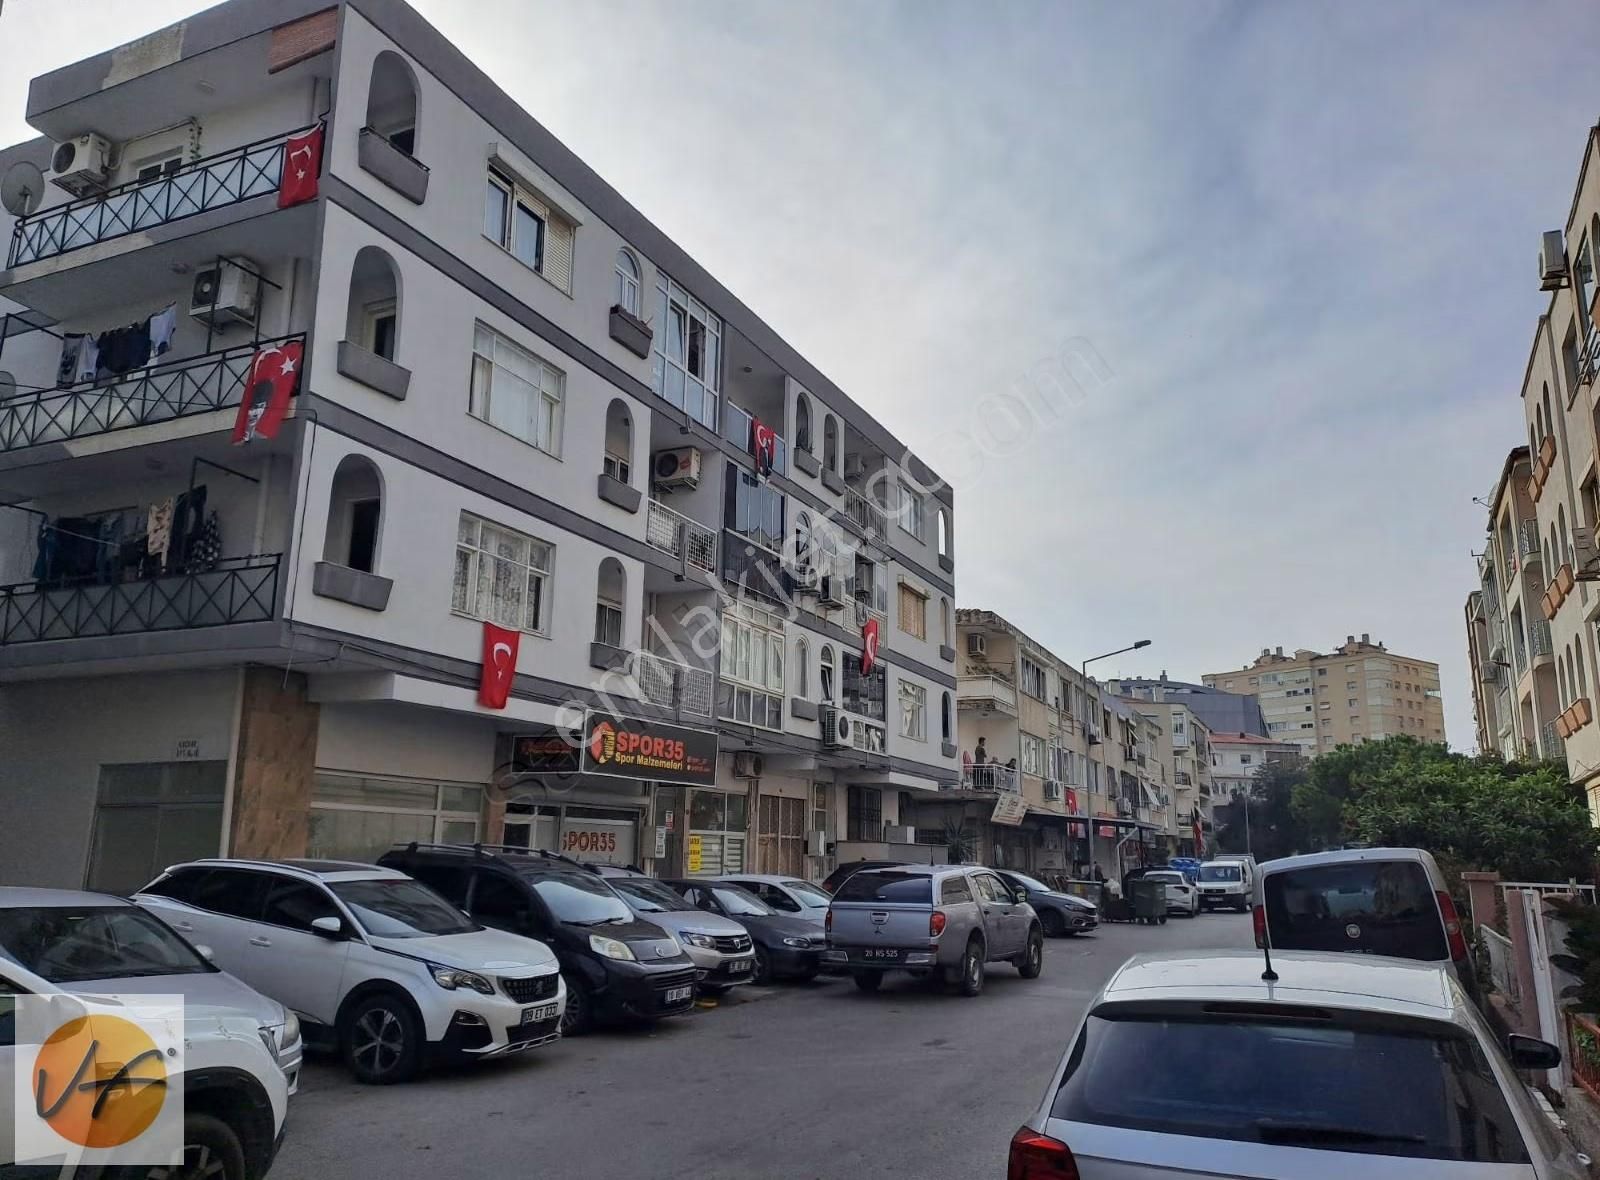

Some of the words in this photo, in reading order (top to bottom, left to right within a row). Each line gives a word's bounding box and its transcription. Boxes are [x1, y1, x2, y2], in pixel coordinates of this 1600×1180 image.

[616, 731, 685, 760] SPOR35
[615, 751, 634, 765] Spor
[637, 754, 684, 771] Malzemeleri
